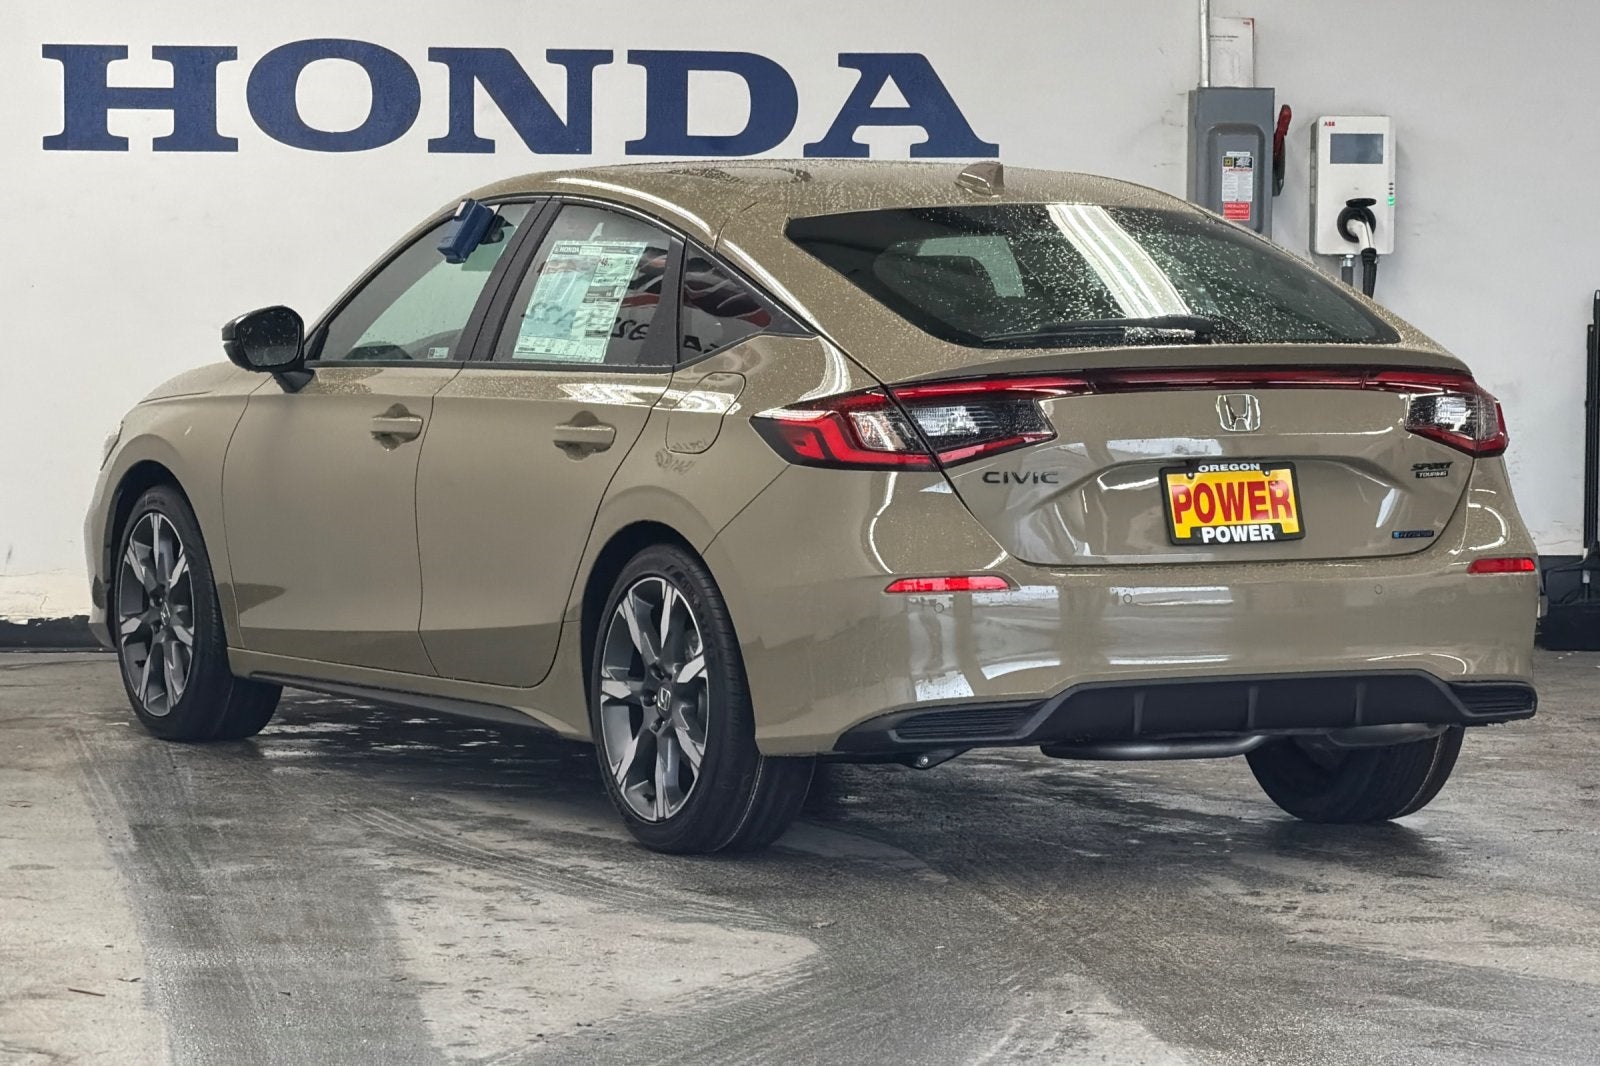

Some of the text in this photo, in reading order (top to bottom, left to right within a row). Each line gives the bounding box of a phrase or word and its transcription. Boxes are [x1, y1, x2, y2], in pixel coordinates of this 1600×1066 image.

[42, 39, 999, 158] HONDA
[559, 245, 580, 253] HONDA
[1198, 463, 1261, 473] OREGON
[982, 471, 1059, 485] CIVIC
[1171, 480, 1293, 524] POWER
[1201, 524, 1276, 544] POWER
